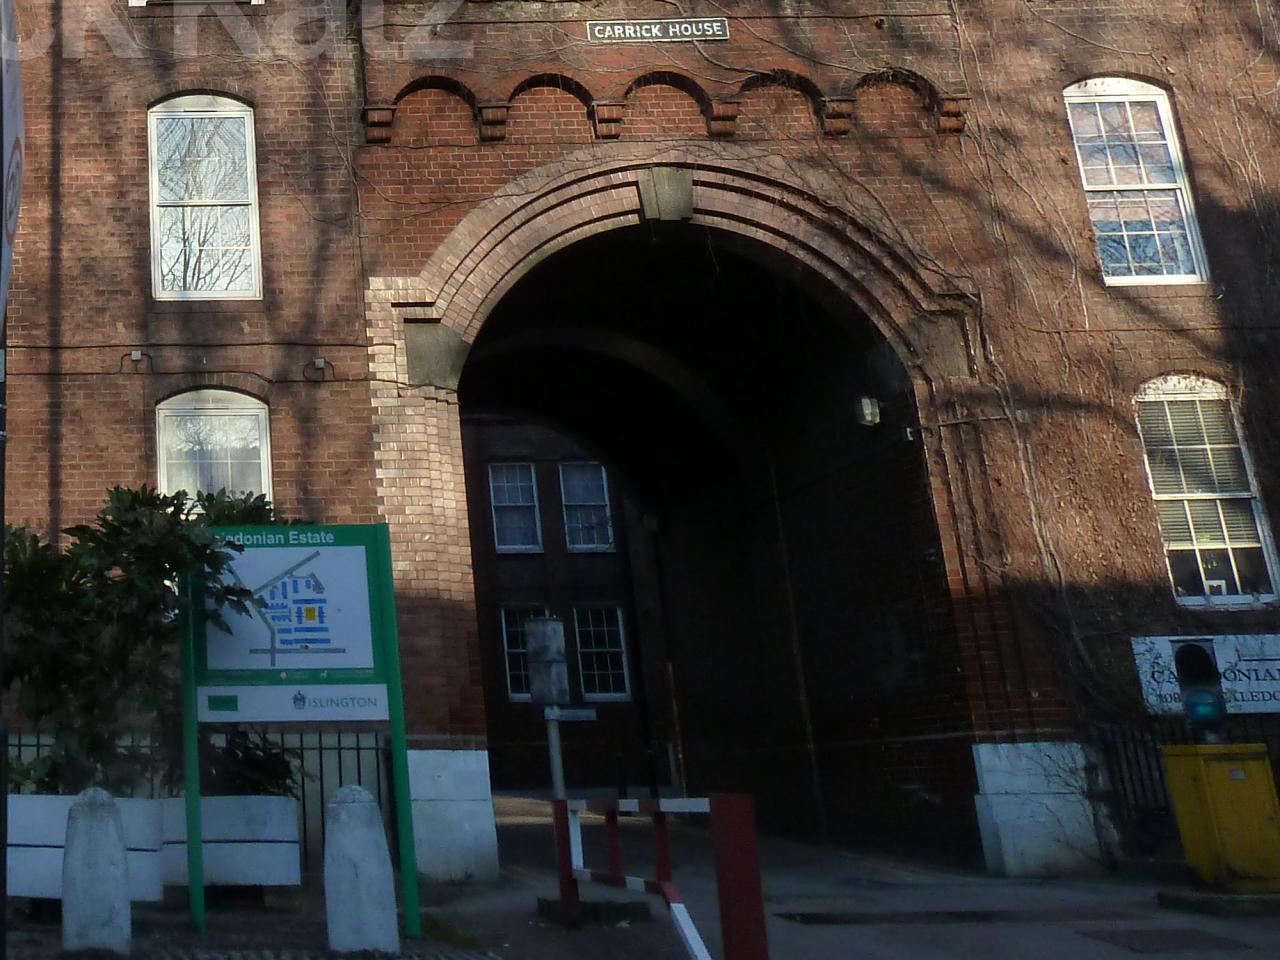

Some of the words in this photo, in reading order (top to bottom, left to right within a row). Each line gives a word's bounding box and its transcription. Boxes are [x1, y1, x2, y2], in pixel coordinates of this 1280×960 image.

[594, 24, 662, 38] CARRICK
[669, 22, 723, 36] HOUSE
[288, 530, 335, 544] Estate
[307, 697, 377, 708] ISLINGTON
